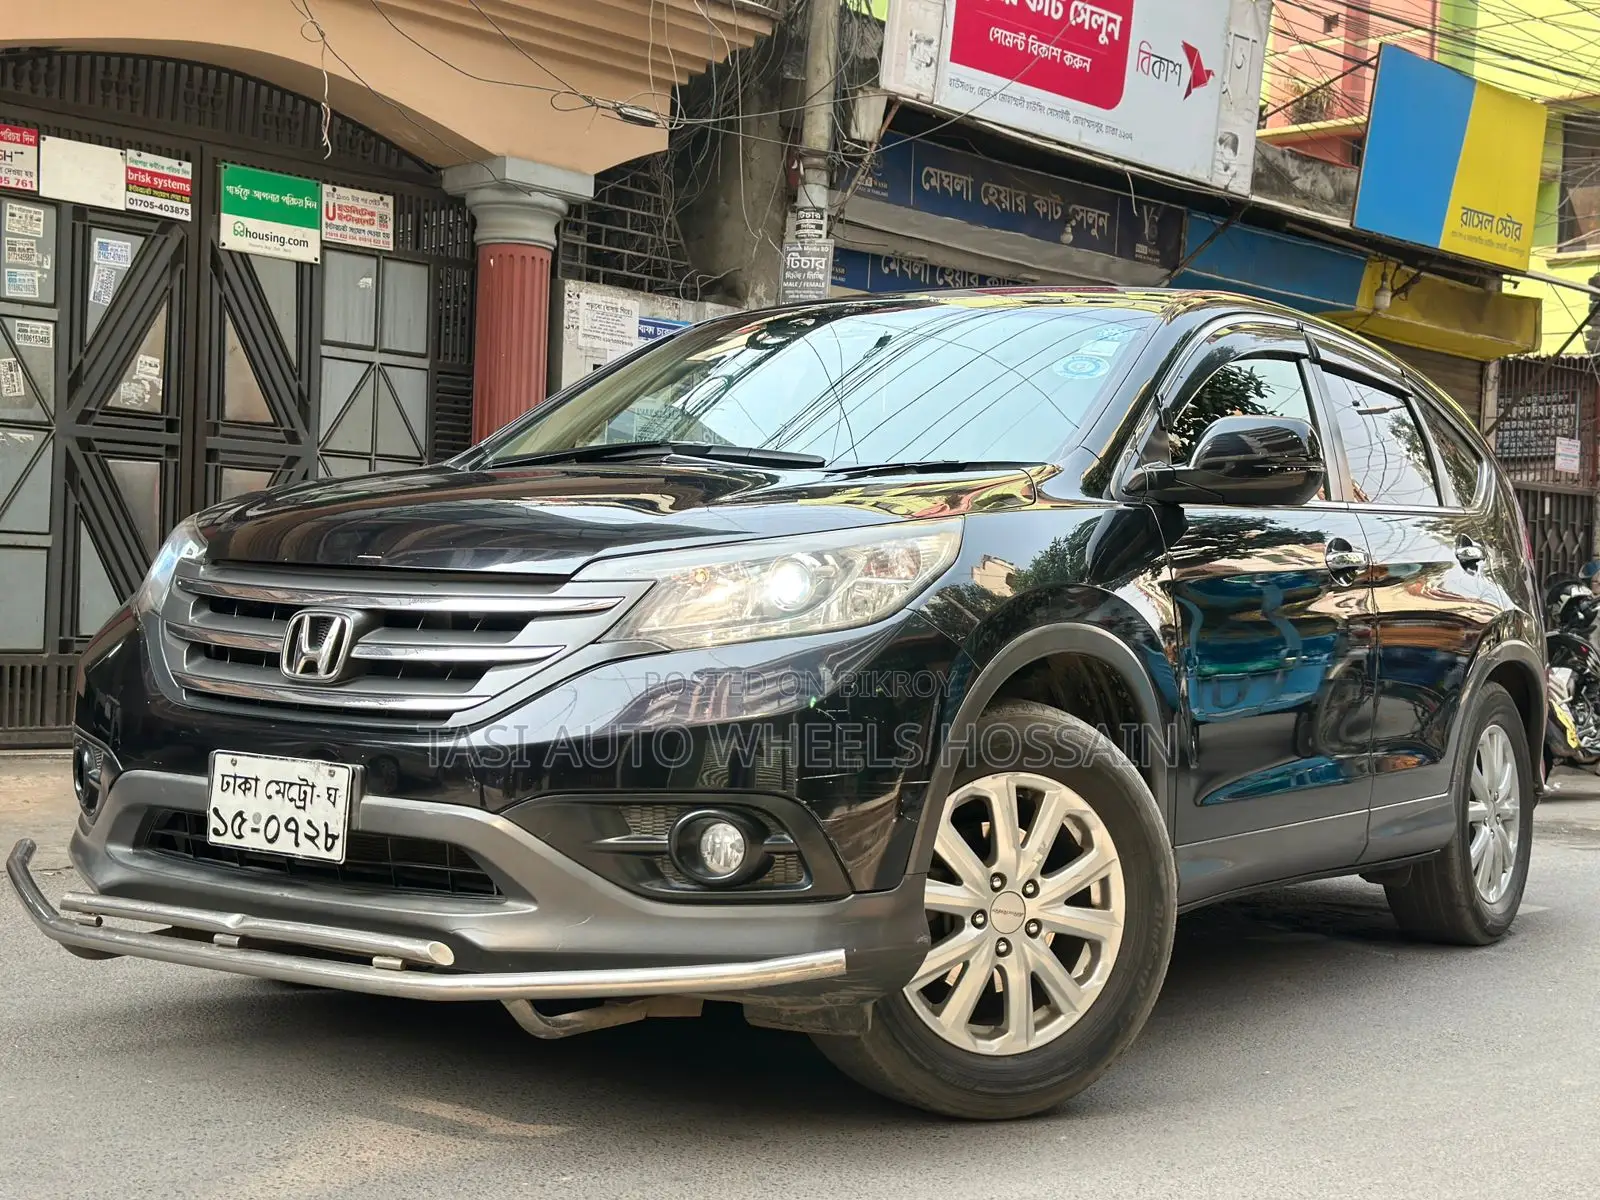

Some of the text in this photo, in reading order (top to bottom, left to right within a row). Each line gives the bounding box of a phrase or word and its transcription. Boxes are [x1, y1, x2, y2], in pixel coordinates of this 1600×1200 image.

[1070, 1, 1123, 45] সেলুন
[989, 26, 1092, 72] পেমেন্ট বিকাশ করুন
[1136, 40, 1182, 88] বিকাশ
[15, 178, 34, 188] 761
[128, 168, 191, 192] brisk systems
[128, 197, 190, 216] 01705-403875
[252, 189, 280, 203] আপনার
[281, 193, 303, 207] পরিচয়
[304, 196, 317, 209] দিন
[921, 164, 974, 203] মেঘলা
[981, 181, 1028, 214] হেয়ার
[1031, 188, 1063, 221] কাট
[1069, 204, 1111, 240] সেলুন
[1460, 206, 1523, 242] রাসেল স্টোর
[245, 227, 309, 248] housing.com
[786, 252, 827, 270] টিচার
[221, 773, 260, 798] ঢাকা
[212, 806, 340, 853] ১৫-০৭২৮
